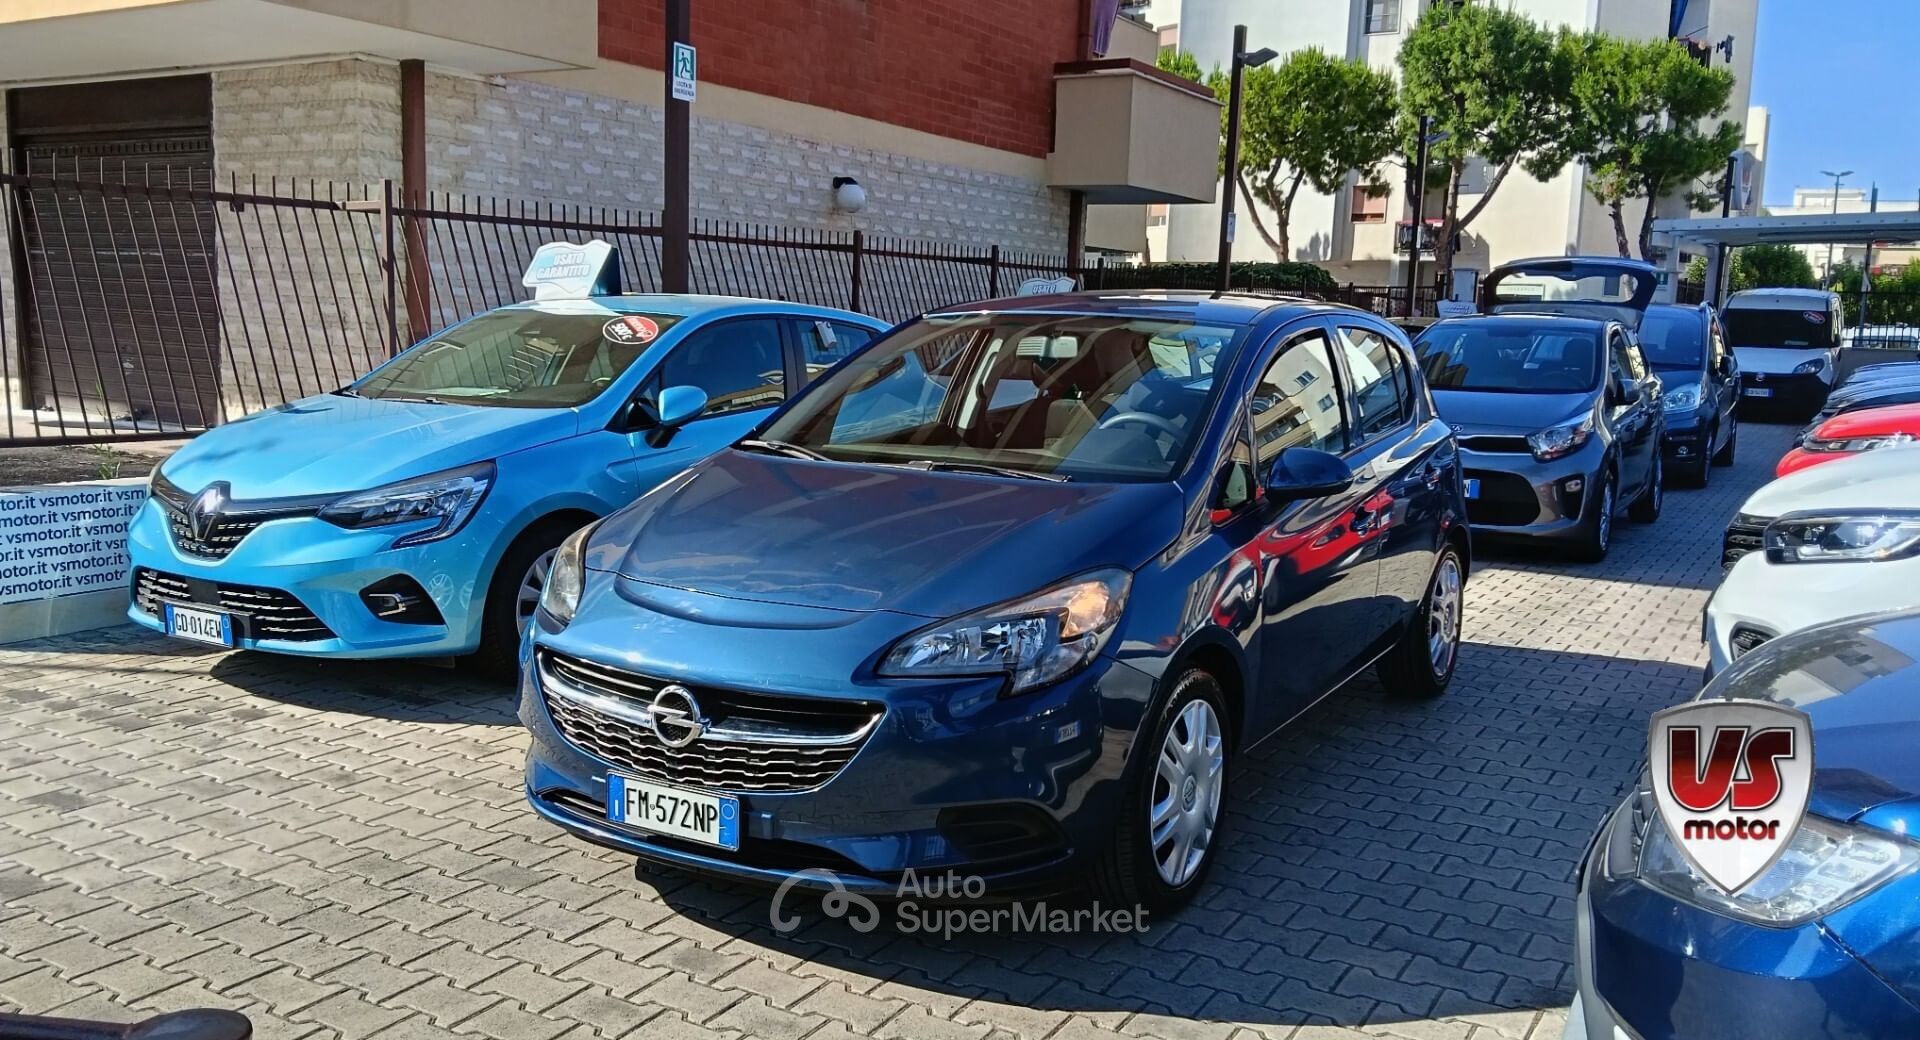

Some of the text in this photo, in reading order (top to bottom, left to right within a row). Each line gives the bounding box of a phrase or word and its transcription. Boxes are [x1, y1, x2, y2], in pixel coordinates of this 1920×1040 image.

[553, 252, 585, 266] USATO
[537, 264, 591, 280] GARANTITO
[0, 496, 36, 511] tor.it
[39, 489, 113, 507] vsmotor.it
[0, 504, 134, 528] motor.it vsmotor.it
[6, 525, 81, 545] vsmotor.it
[84, 521, 130, 536] vsmot
[27, 539, 101, 559] vsmotor.it
[0, 561, 48, 580] otor.it
[50, 552, 124, 573] vsmotor.it
